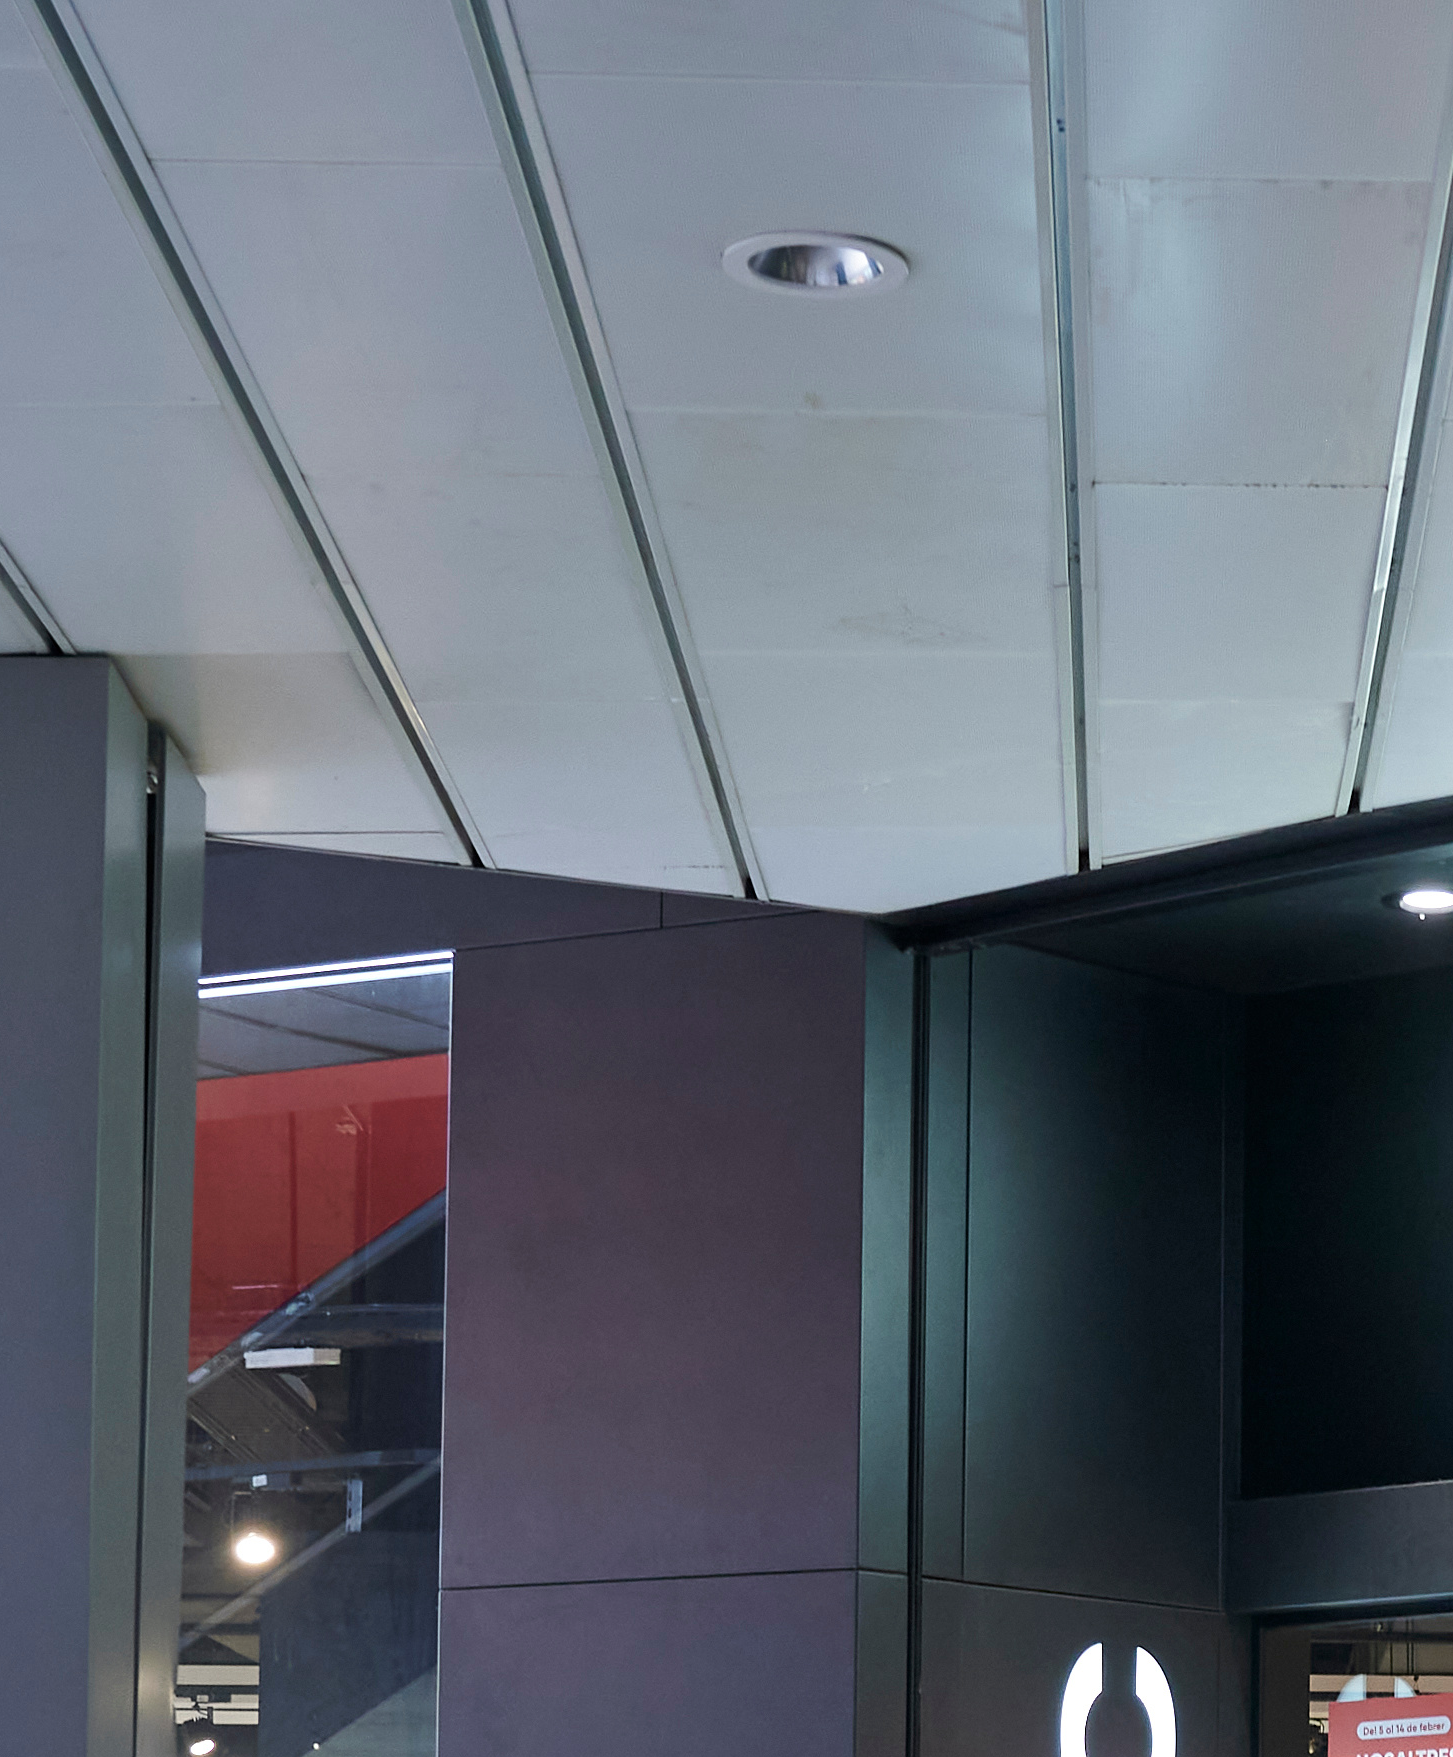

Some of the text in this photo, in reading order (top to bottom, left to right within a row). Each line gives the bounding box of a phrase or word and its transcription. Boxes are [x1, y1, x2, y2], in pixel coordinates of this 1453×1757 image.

[1364, 1727, 1376, 1735] Del
[1379, 1726, 1383, 1734] 5
[1386, 1725, 1393, 1734] al
[1396, 1725, 1404, 1733] 14
[1407, 1723, 1417, 1732] de
